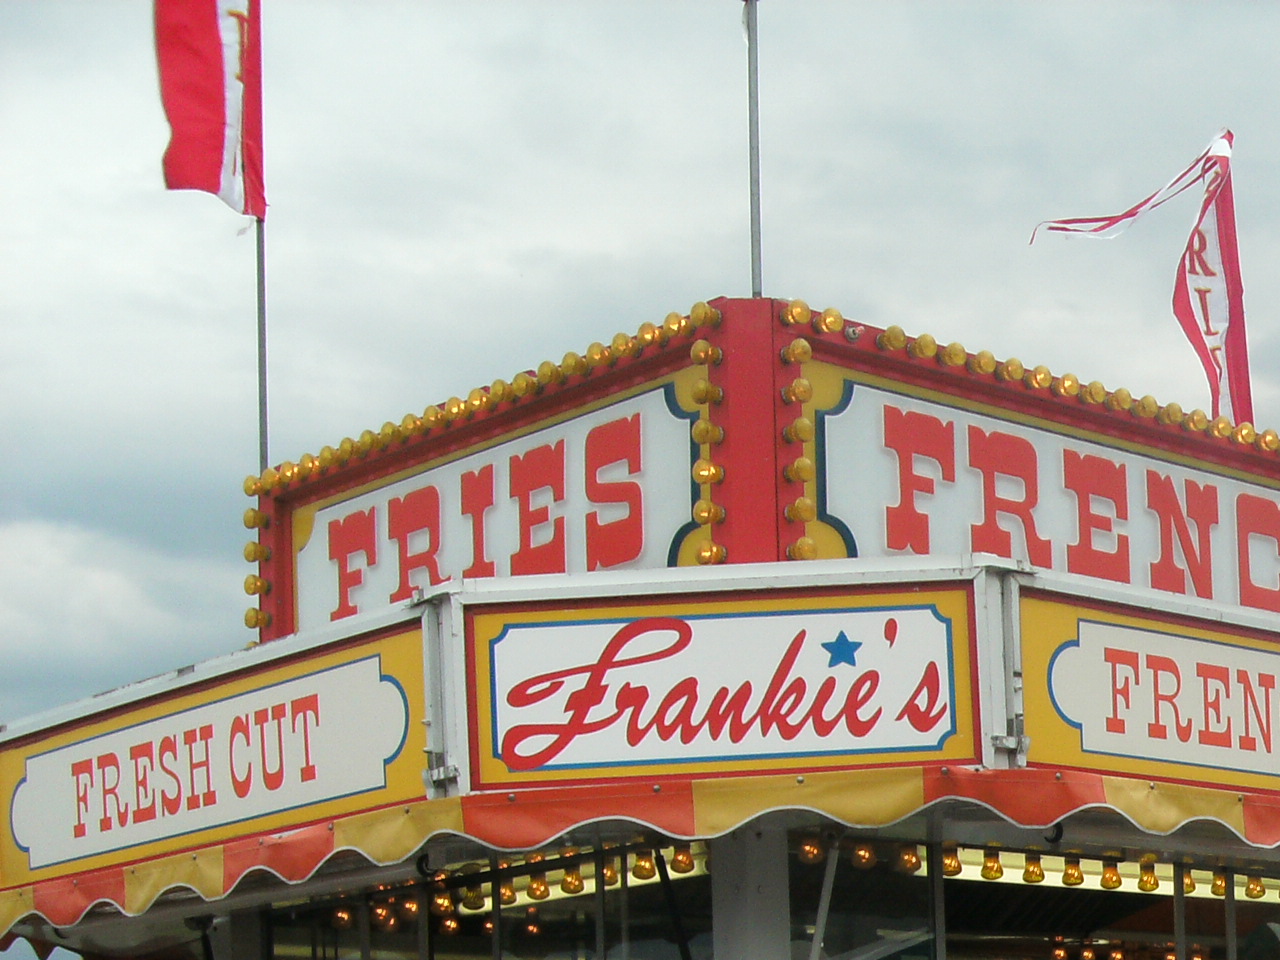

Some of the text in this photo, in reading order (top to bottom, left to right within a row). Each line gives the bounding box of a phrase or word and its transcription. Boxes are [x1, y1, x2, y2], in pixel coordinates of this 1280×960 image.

[327, 411, 646, 622] FRIES
[71, 693, 320, 839] FRESH CUT
[501, 616, 947, 771] Frankie's
